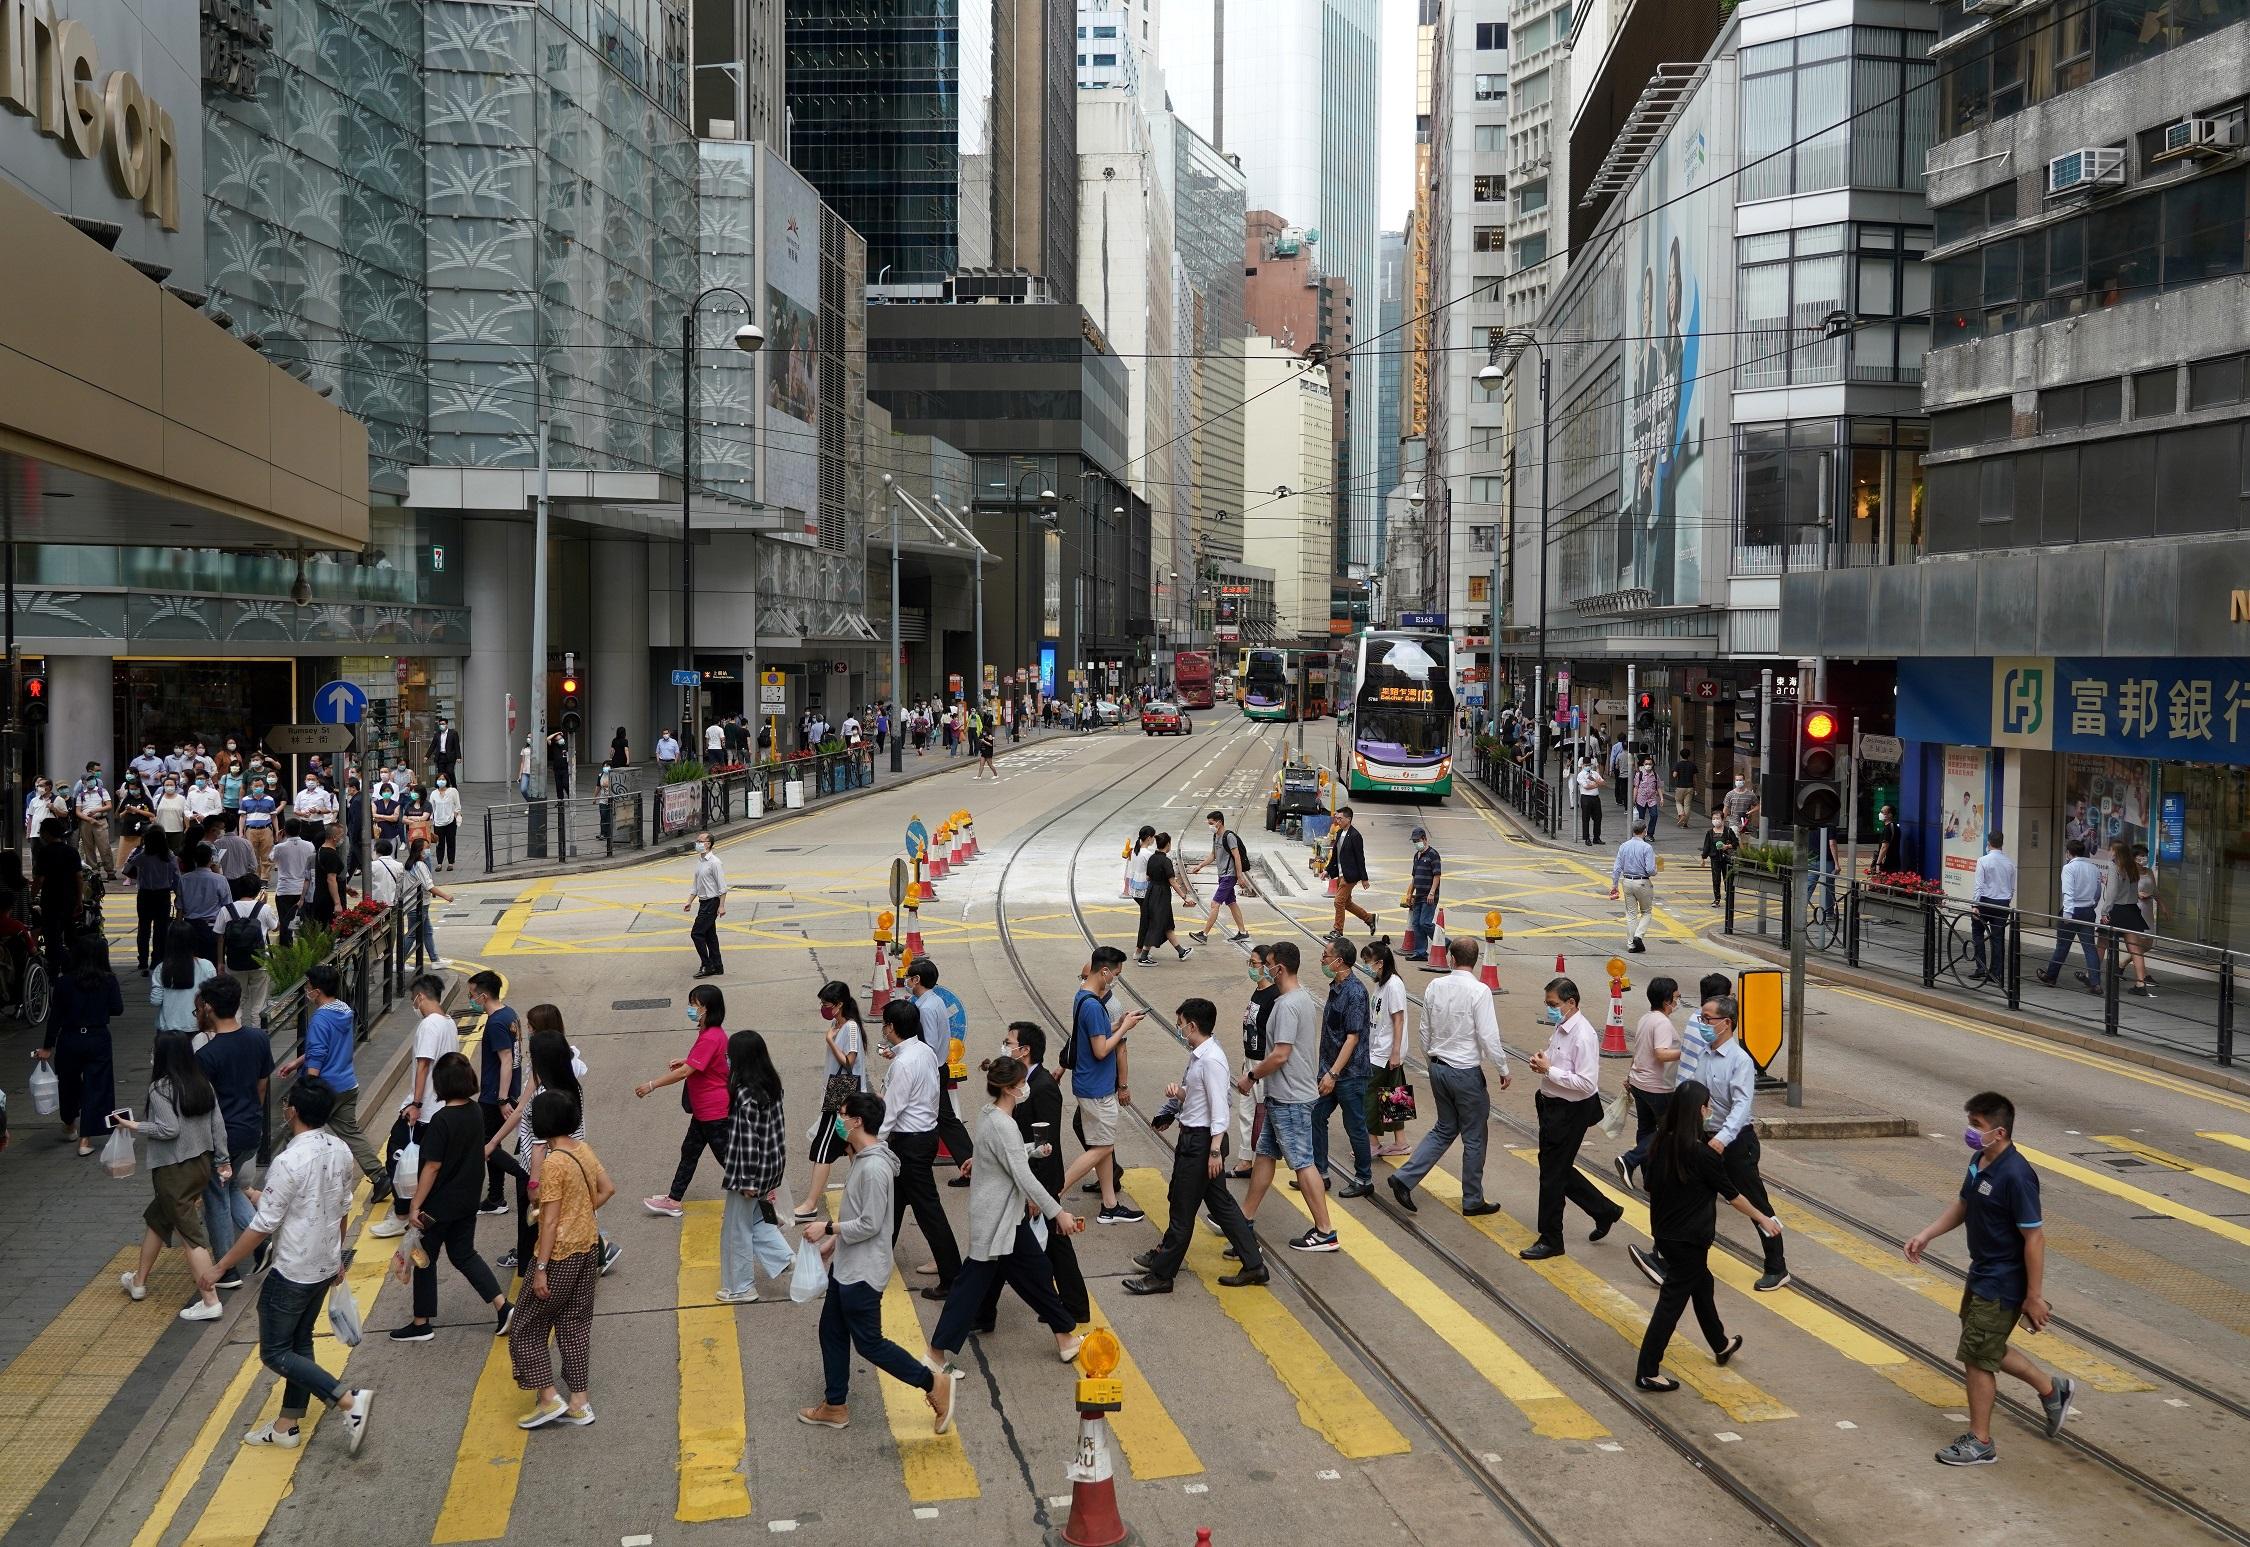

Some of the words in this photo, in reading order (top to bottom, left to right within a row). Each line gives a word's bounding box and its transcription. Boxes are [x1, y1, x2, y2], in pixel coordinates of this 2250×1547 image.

[1417, 690, 1434, 702] 113
[291, 736, 328, 744] 林士街
